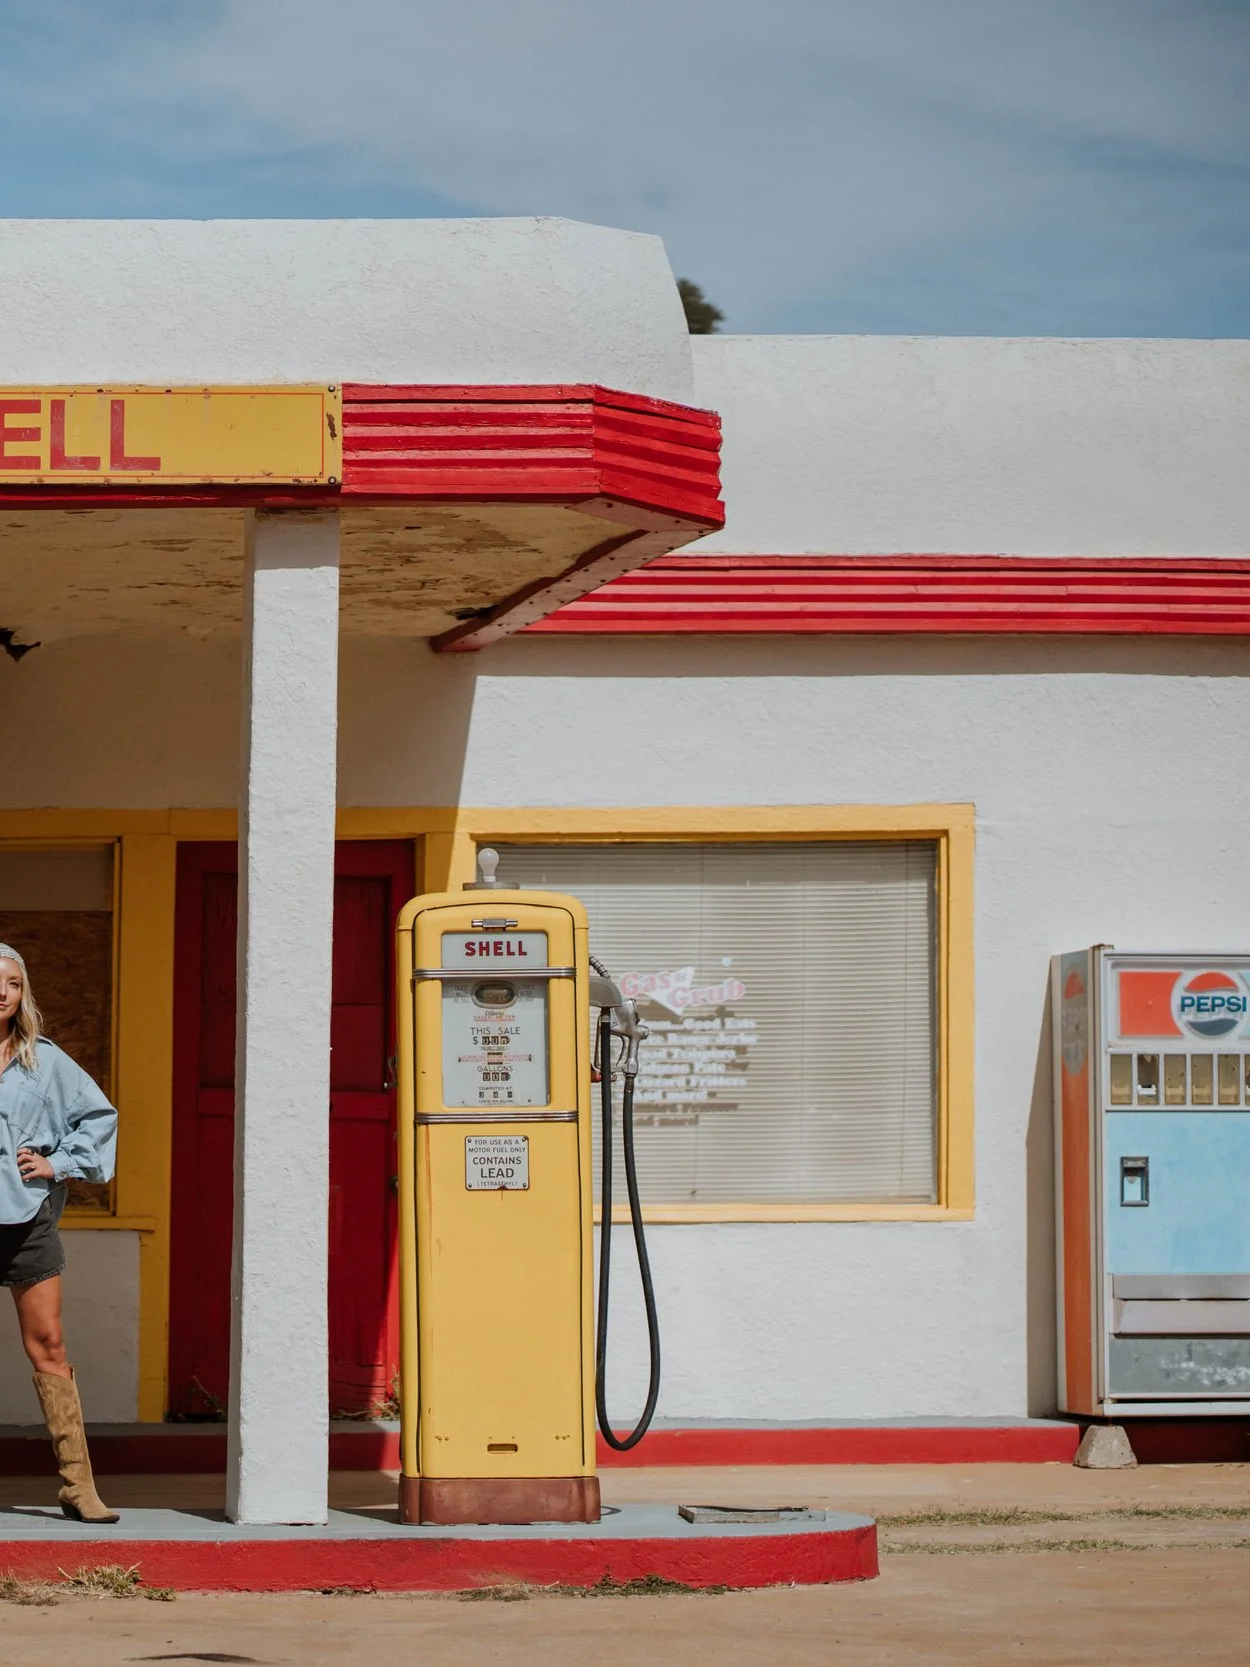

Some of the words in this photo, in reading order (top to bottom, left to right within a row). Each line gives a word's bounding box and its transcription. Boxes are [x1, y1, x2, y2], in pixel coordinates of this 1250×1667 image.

[464, 941, 528, 956] SHELL
[620, 972, 671, 997] Gas
[670, 980, 745, 1008] Grub
[1180, 996, 1247, 1012] PEPSI
[470, 1027, 491, 1035] THIS
[497, 1027, 521, 1035] SALE
[472, 1156, 522, 1165] CONTAINS
[480, 1167, 515, 1178] LEAD
